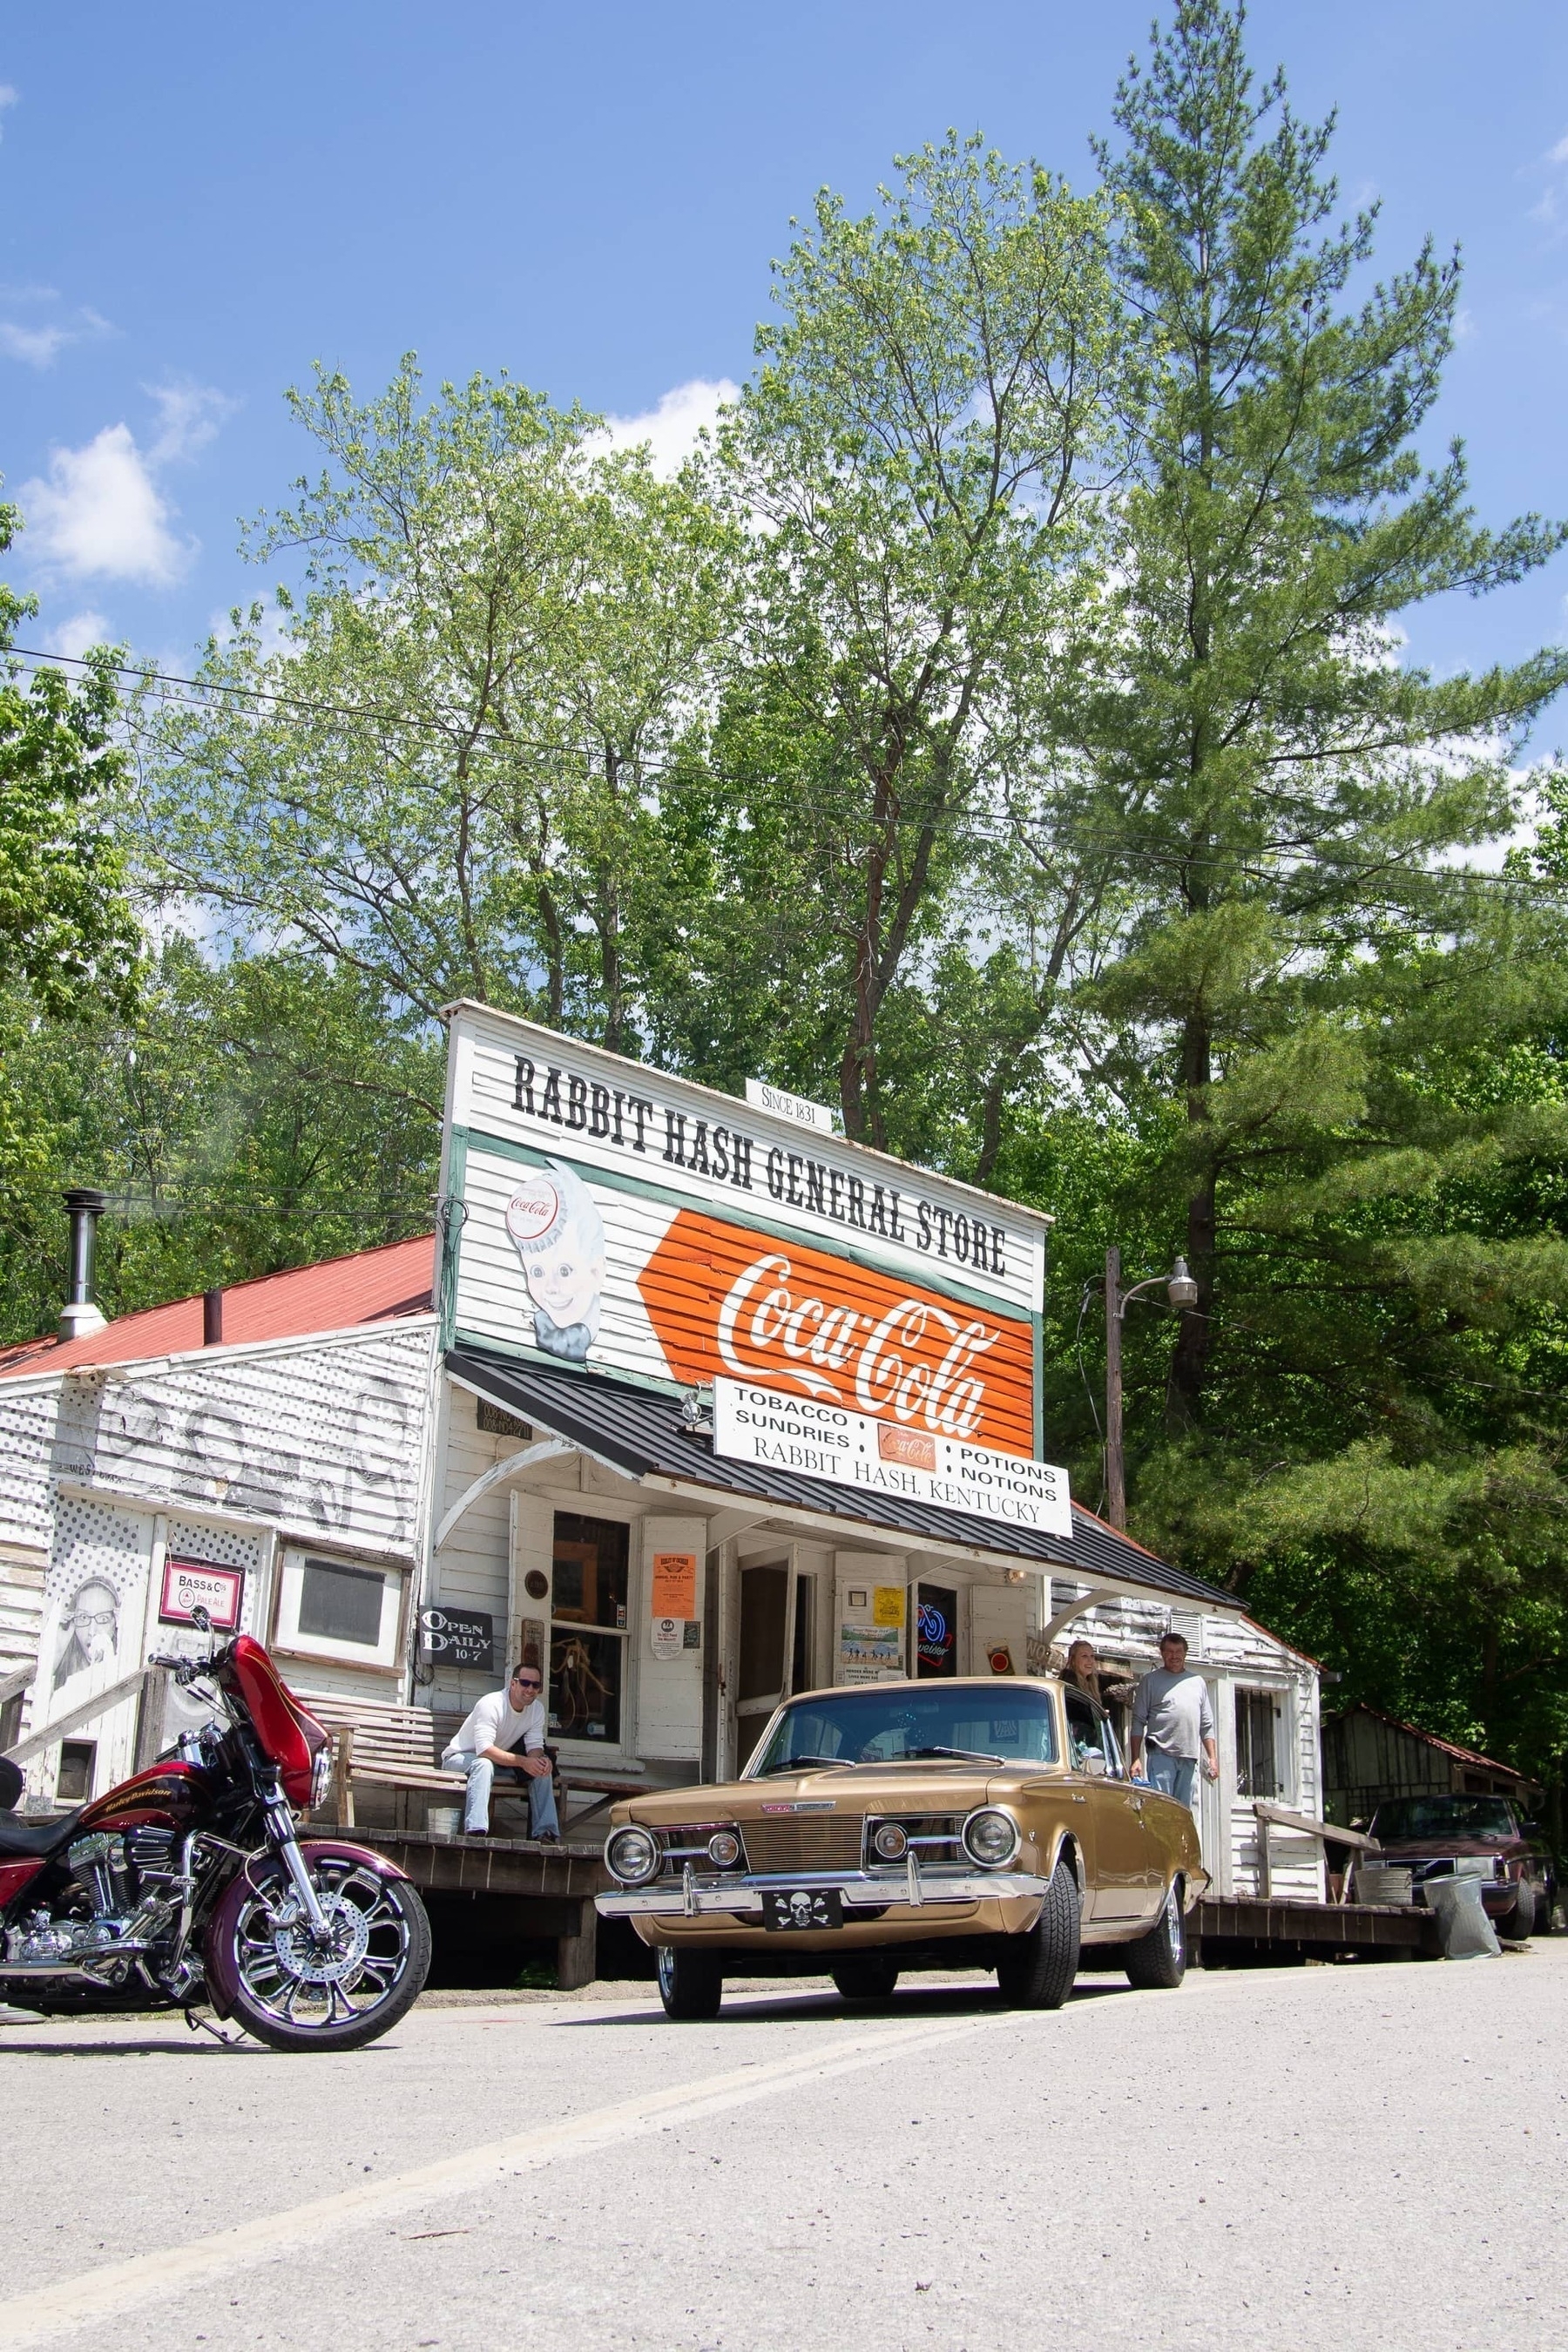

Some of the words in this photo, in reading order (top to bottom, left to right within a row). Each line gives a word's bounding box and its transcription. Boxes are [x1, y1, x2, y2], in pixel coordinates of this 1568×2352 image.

[762, 1086, 793, 1115] SINCE
[796, 1103, 815, 1124] 1831
[511, 1055, 652, 1152] RABBIT
[663, 1109, 754, 1190] HASH
[766, 1147, 905, 1242] GENERAL
[916, 1200, 1005, 1276] STORE
[510, 1196, 552, 1217] Coca-Cola
[718, 1254, 1001, 1437] Coca-Cola
[734, 1387, 848, 1426] TOBACCO
[735, 1409, 850, 1448] SUNDRIES
[754, 1436, 841, 1475] RABBIT
[855, 1461, 922, 1496] HASH,
[930, 1481, 1039, 1524] KENTUCKY
[962, 1448, 1056, 1484] POTIONS
[962, 1467, 1057, 1502] NOTIONS
[422, 1611, 483, 1636] OPEN
[422, 1631, 491, 1651] DAILY
